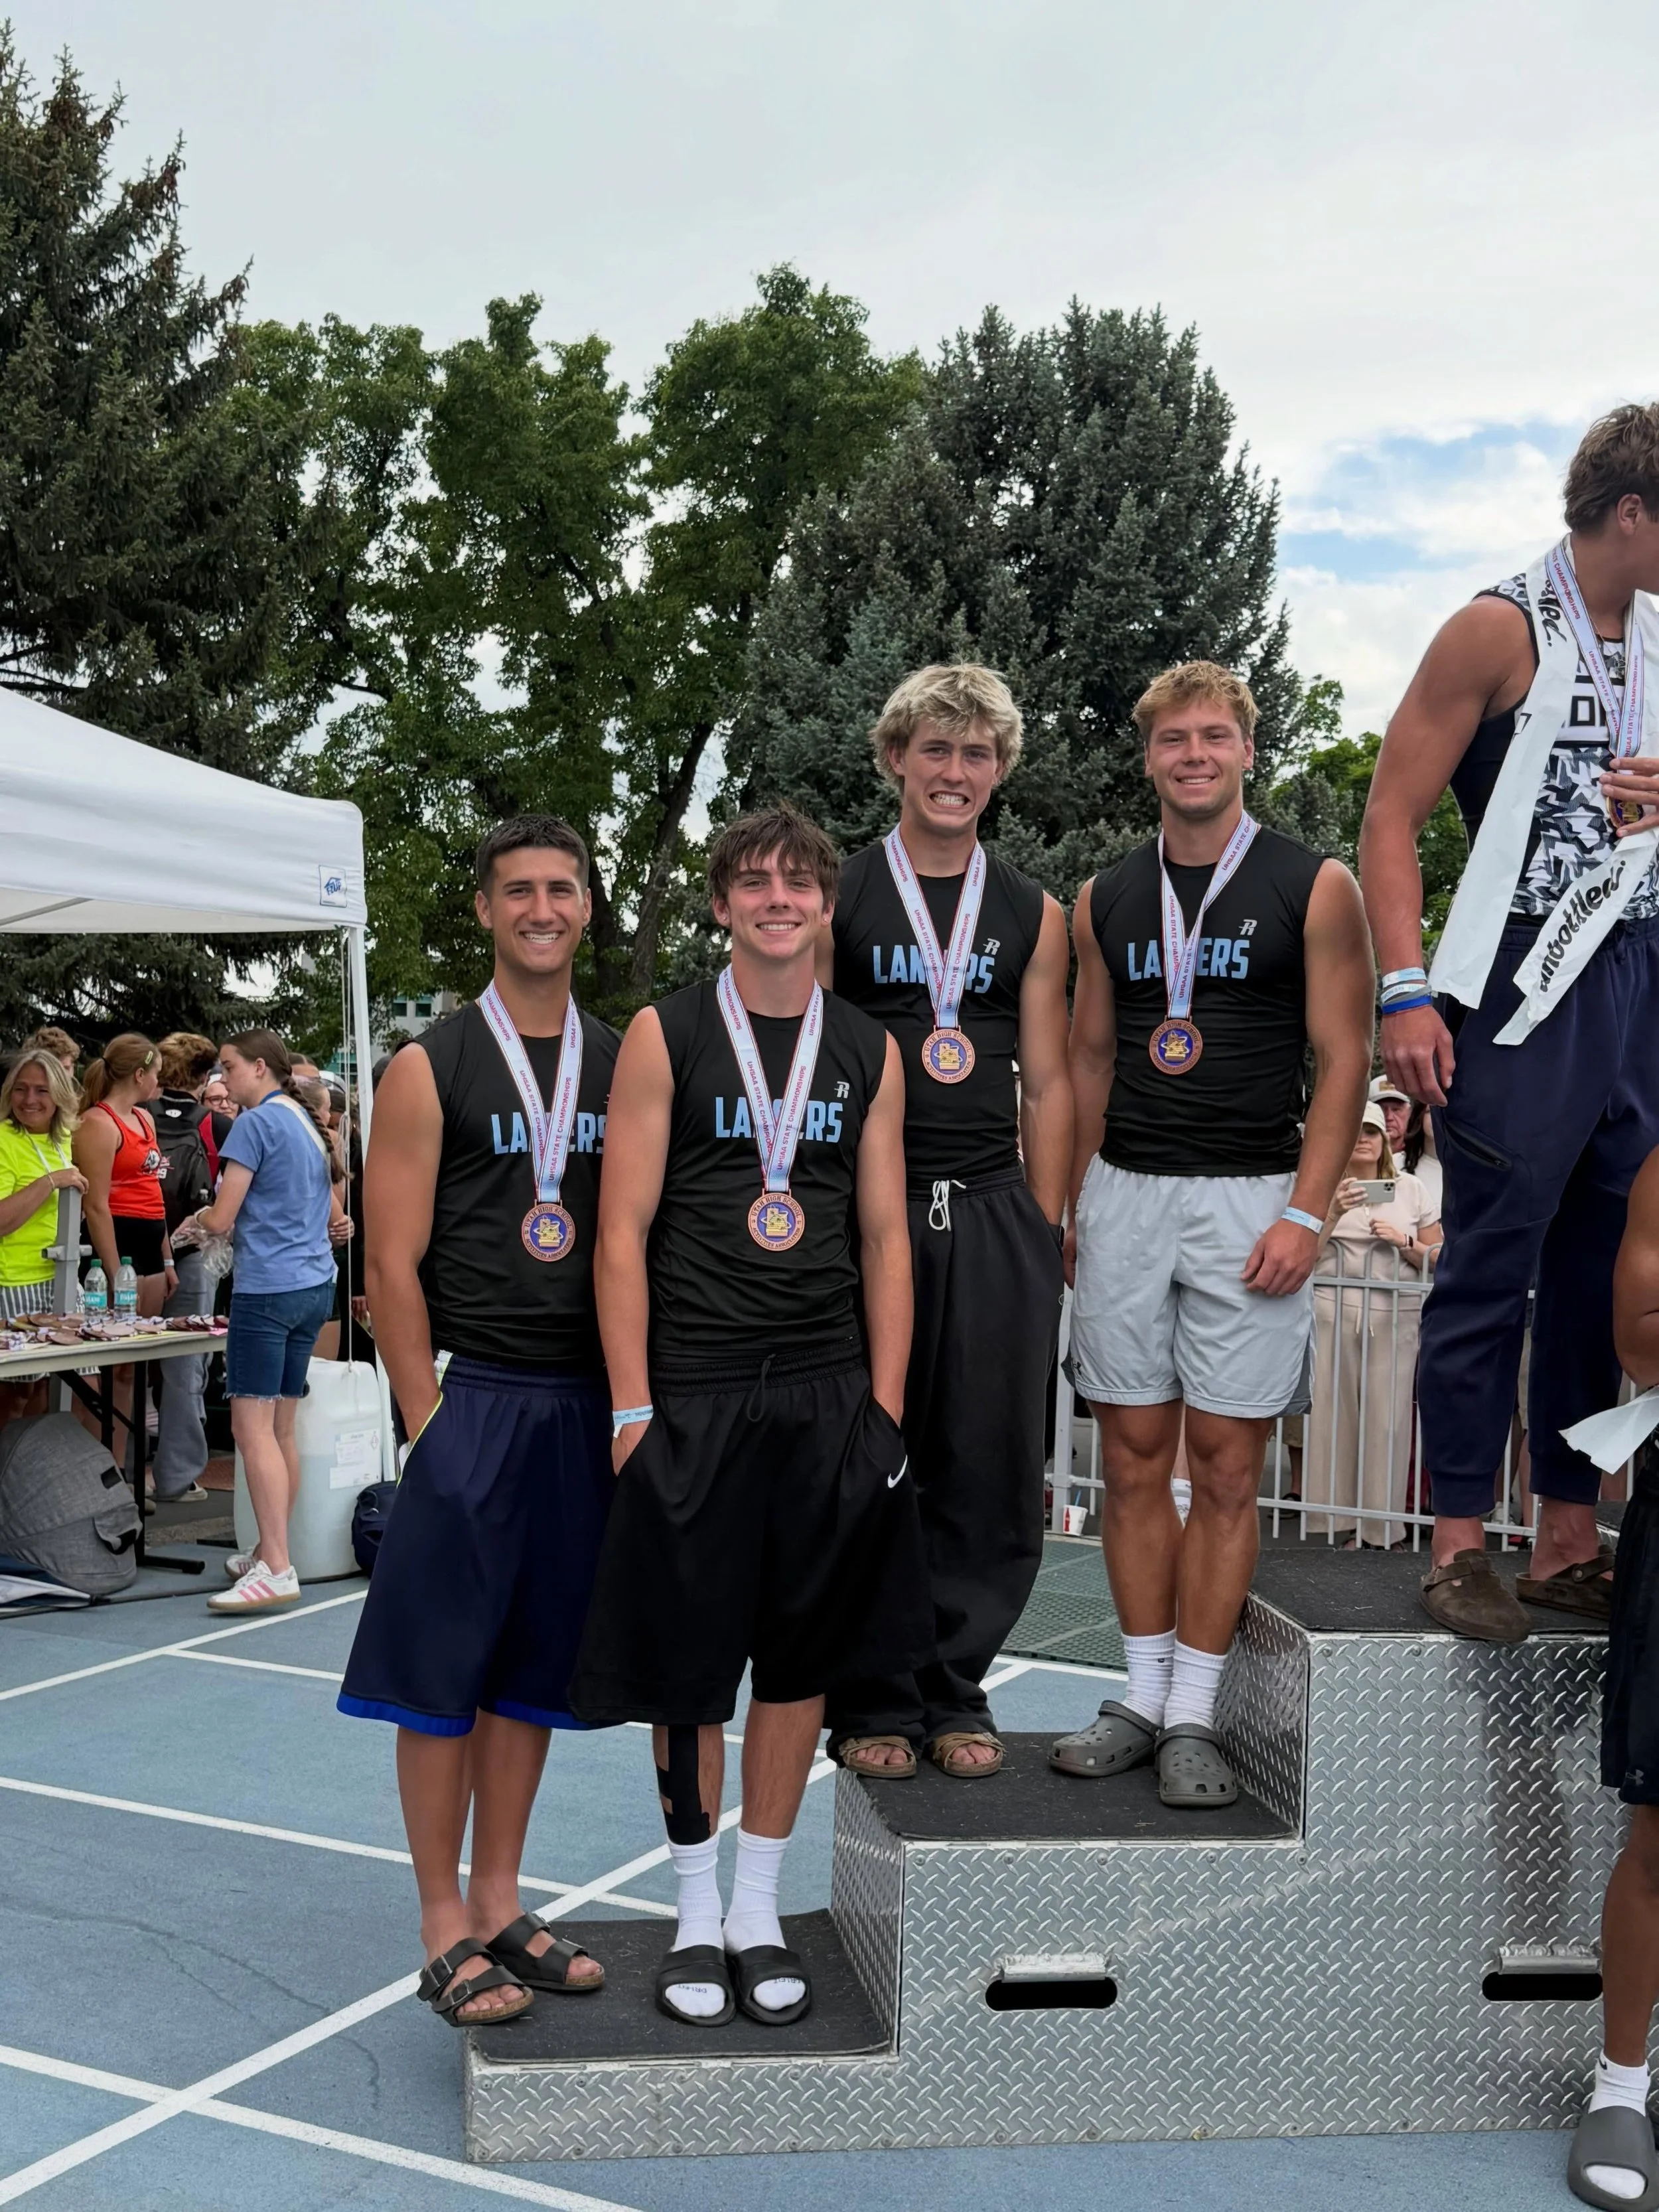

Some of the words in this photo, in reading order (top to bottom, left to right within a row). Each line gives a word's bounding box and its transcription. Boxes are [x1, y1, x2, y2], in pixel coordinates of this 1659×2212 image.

[914, 909, 926, 931] UHSAA
[922, 932, 933, 954] STATE
[954, 913, 971, 965] CHAMPIONSHIPS
[950, 966, 960, 986] STATE
[1127, 938, 1251, 982] LAERS
[485, 994, 512, 1042] CHAMPIONSHIPS
[723, 978, 742, 1031] CHAMPIONSHIPS
[946, 987, 956, 1009] UHSAA
[520, 1070, 532, 1093] UHSAA
[528, 1094, 540, 1115] STATE
[557, 1076, 572, 1132] CHAMPIONSHIPS
[747, 1061, 758, 1085] UHSAA
[754, 1086, 764, 1108] STATE
[715, 1096, 843, 1143] LARS
[776, 1147, 787, 1170] UHSAA
[782, 1124, 793, 1146] STATE
[788, 1065, 807, 1123] CHAMPIONSHIPS
[553, 1134, 563, 1156] STATE
[548, 1157, 557, 1181] UHSAA
[751, 1200, 765, 1217] UTAH
[783, 1197, 802, 1218] SCHOOL
